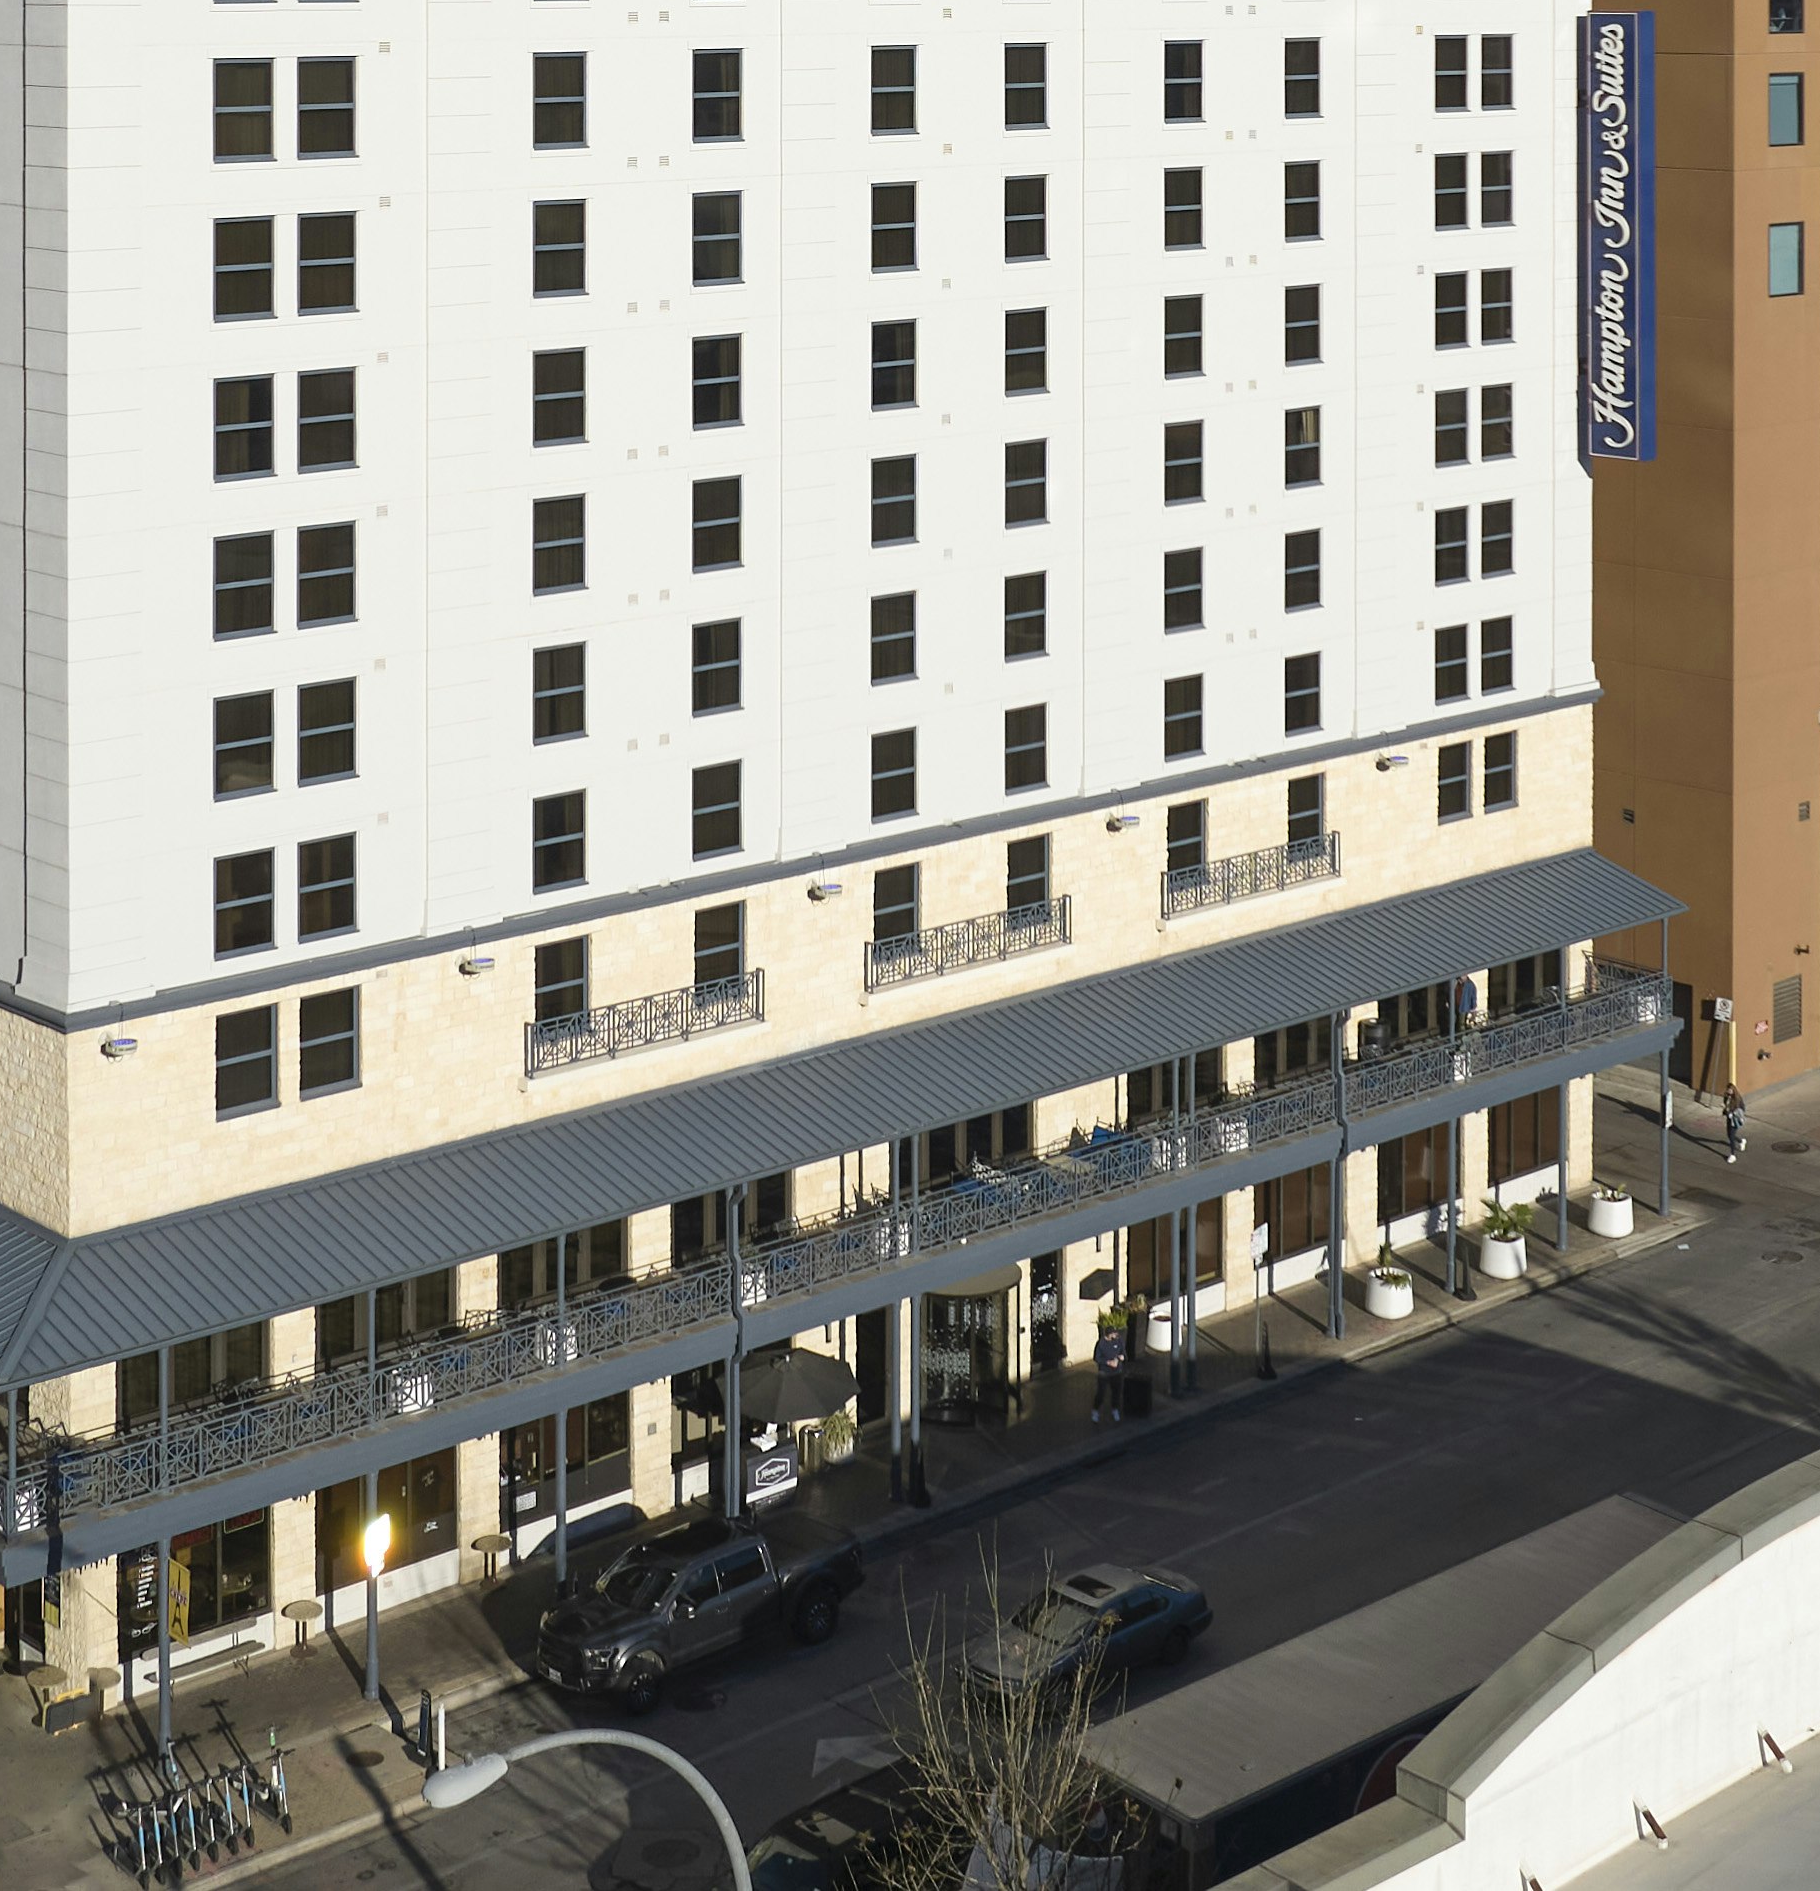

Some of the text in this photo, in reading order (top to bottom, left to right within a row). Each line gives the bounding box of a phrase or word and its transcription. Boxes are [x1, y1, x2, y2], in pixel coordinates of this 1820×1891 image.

[1594, 23, 1627, 128] Suites
[1594, 150, 1630, 249] Inn
[1590, 253, 1635, 448] Hampton
